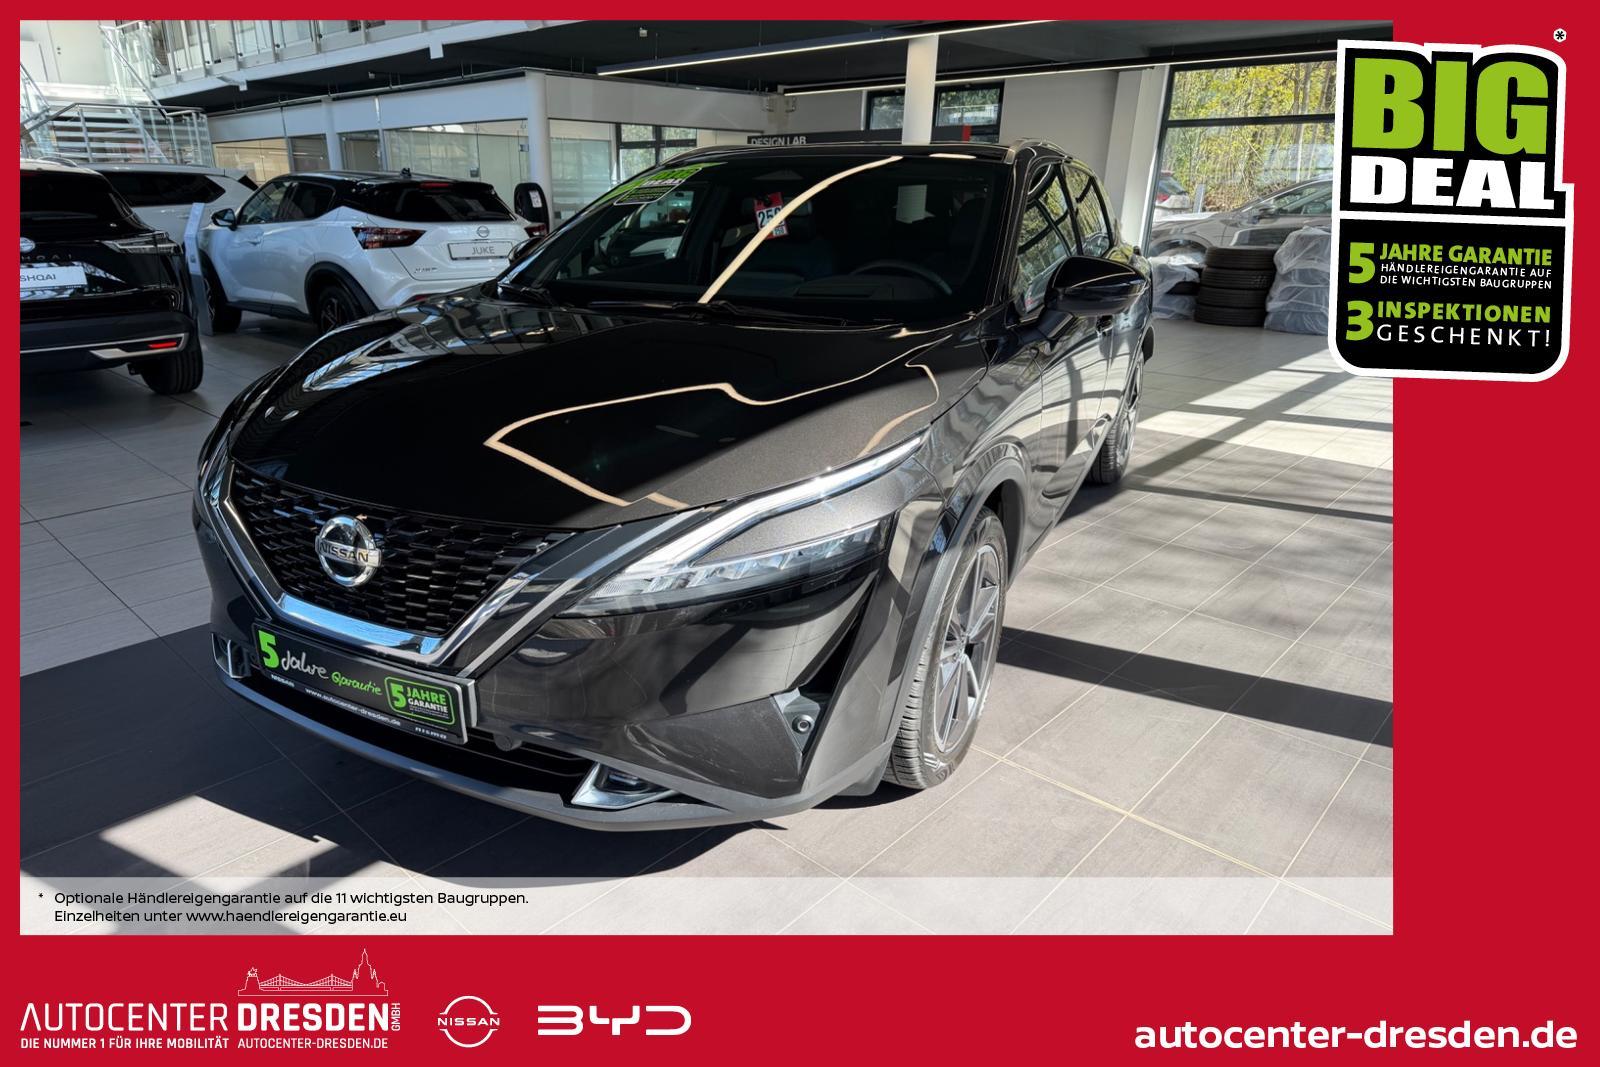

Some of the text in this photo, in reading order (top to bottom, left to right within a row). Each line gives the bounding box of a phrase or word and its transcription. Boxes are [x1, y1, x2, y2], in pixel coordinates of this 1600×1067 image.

[750, 137, 785, 146] DESIGN
[472, 246, 495, 255] JUKE
[320, 542, 369, 562] NISSAN
[258, 630, 279, 669] 5
[390, 683, 447, 708] 5 JAHRE
[407, 698, 449, 713] GARANTIE
